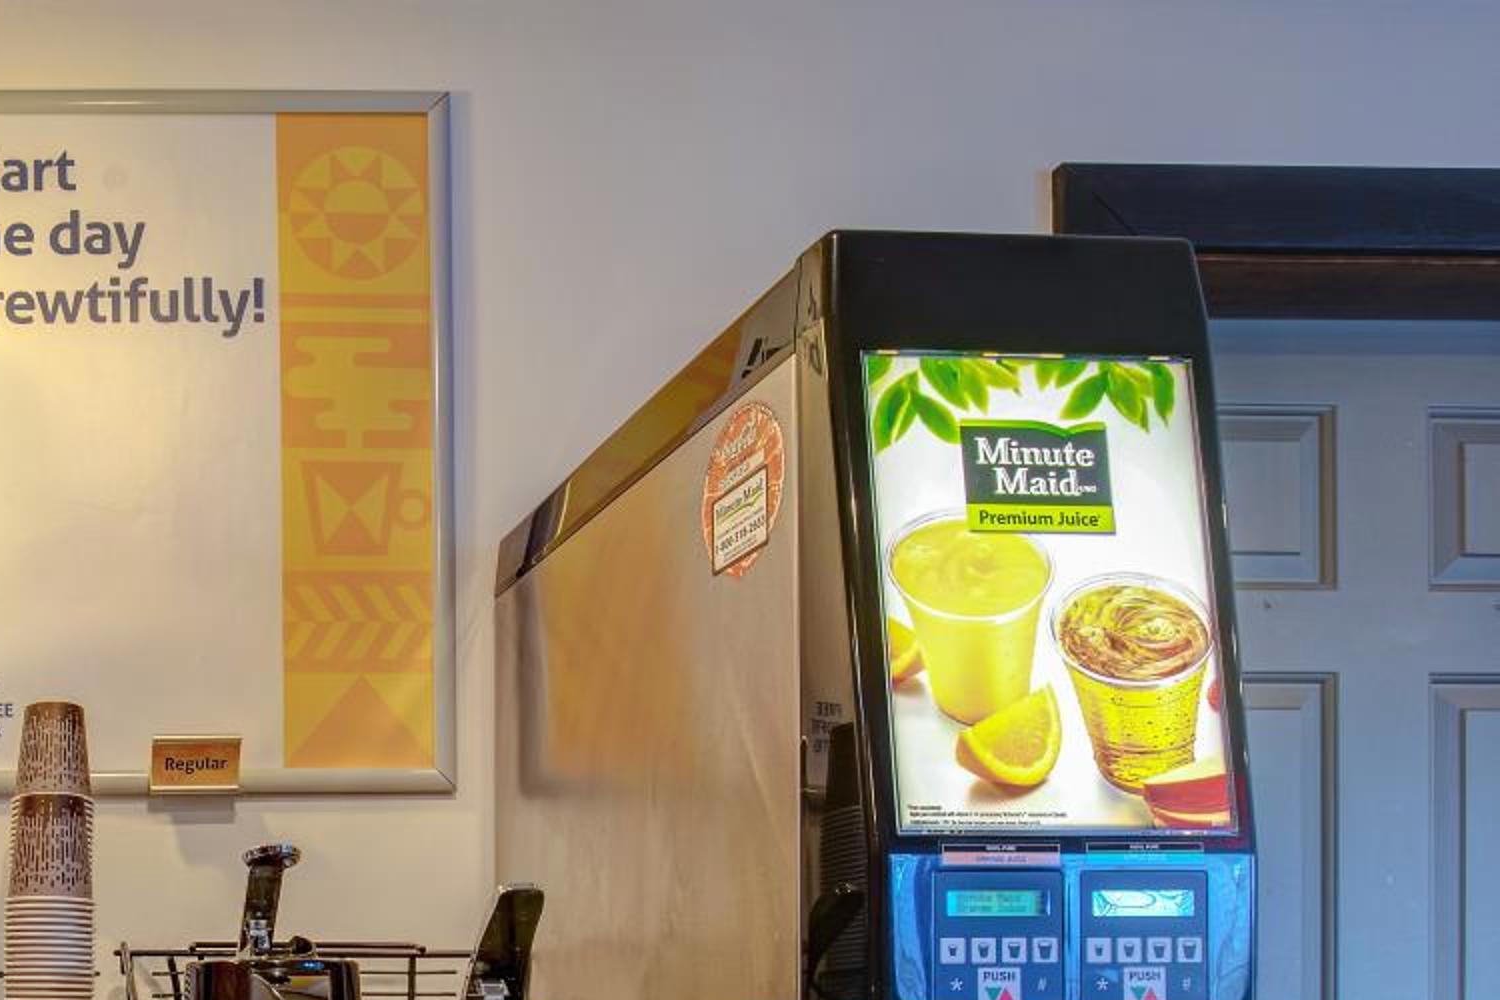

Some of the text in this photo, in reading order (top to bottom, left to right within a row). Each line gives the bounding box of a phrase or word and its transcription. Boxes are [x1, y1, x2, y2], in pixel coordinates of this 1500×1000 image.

[49, 210, 145, 269] day
[974, 437, 1096, 467] Minute
[992, 467, 1081, 497] Maid
[979, 510, 1100, 527] Premium Juice
[165, 756, 229, 775] Regular
[983, 970, 1017, 982] PUSH
[1128, 971, 1161, 982] PUSH
